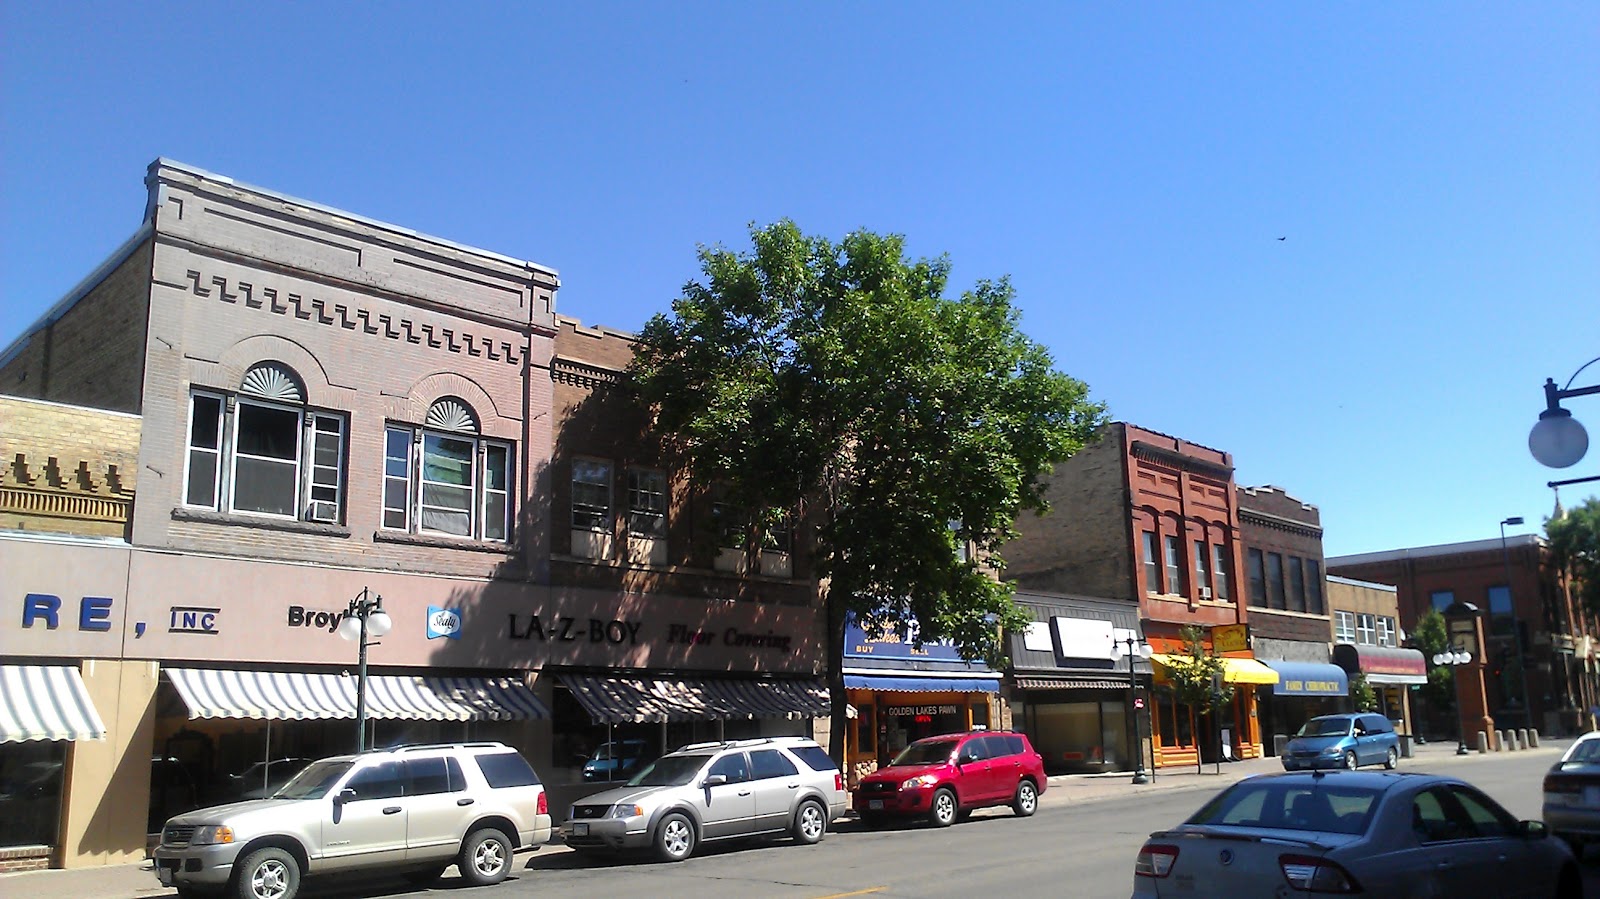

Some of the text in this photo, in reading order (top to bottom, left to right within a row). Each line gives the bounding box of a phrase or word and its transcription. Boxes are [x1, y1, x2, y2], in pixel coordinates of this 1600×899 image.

[170, 611, 215, 631] INC
[288, 605, 349, 633] Broy
[433, 611, 457, 633] Sealy
[509, 613, 642, 645] LA-Z-BOY
[667, 623, 792, 653] Floor Covering
[856, 645, 874, 654] BUY
[888, 705, 956, 716] GOLDEN LAKES PAWN
